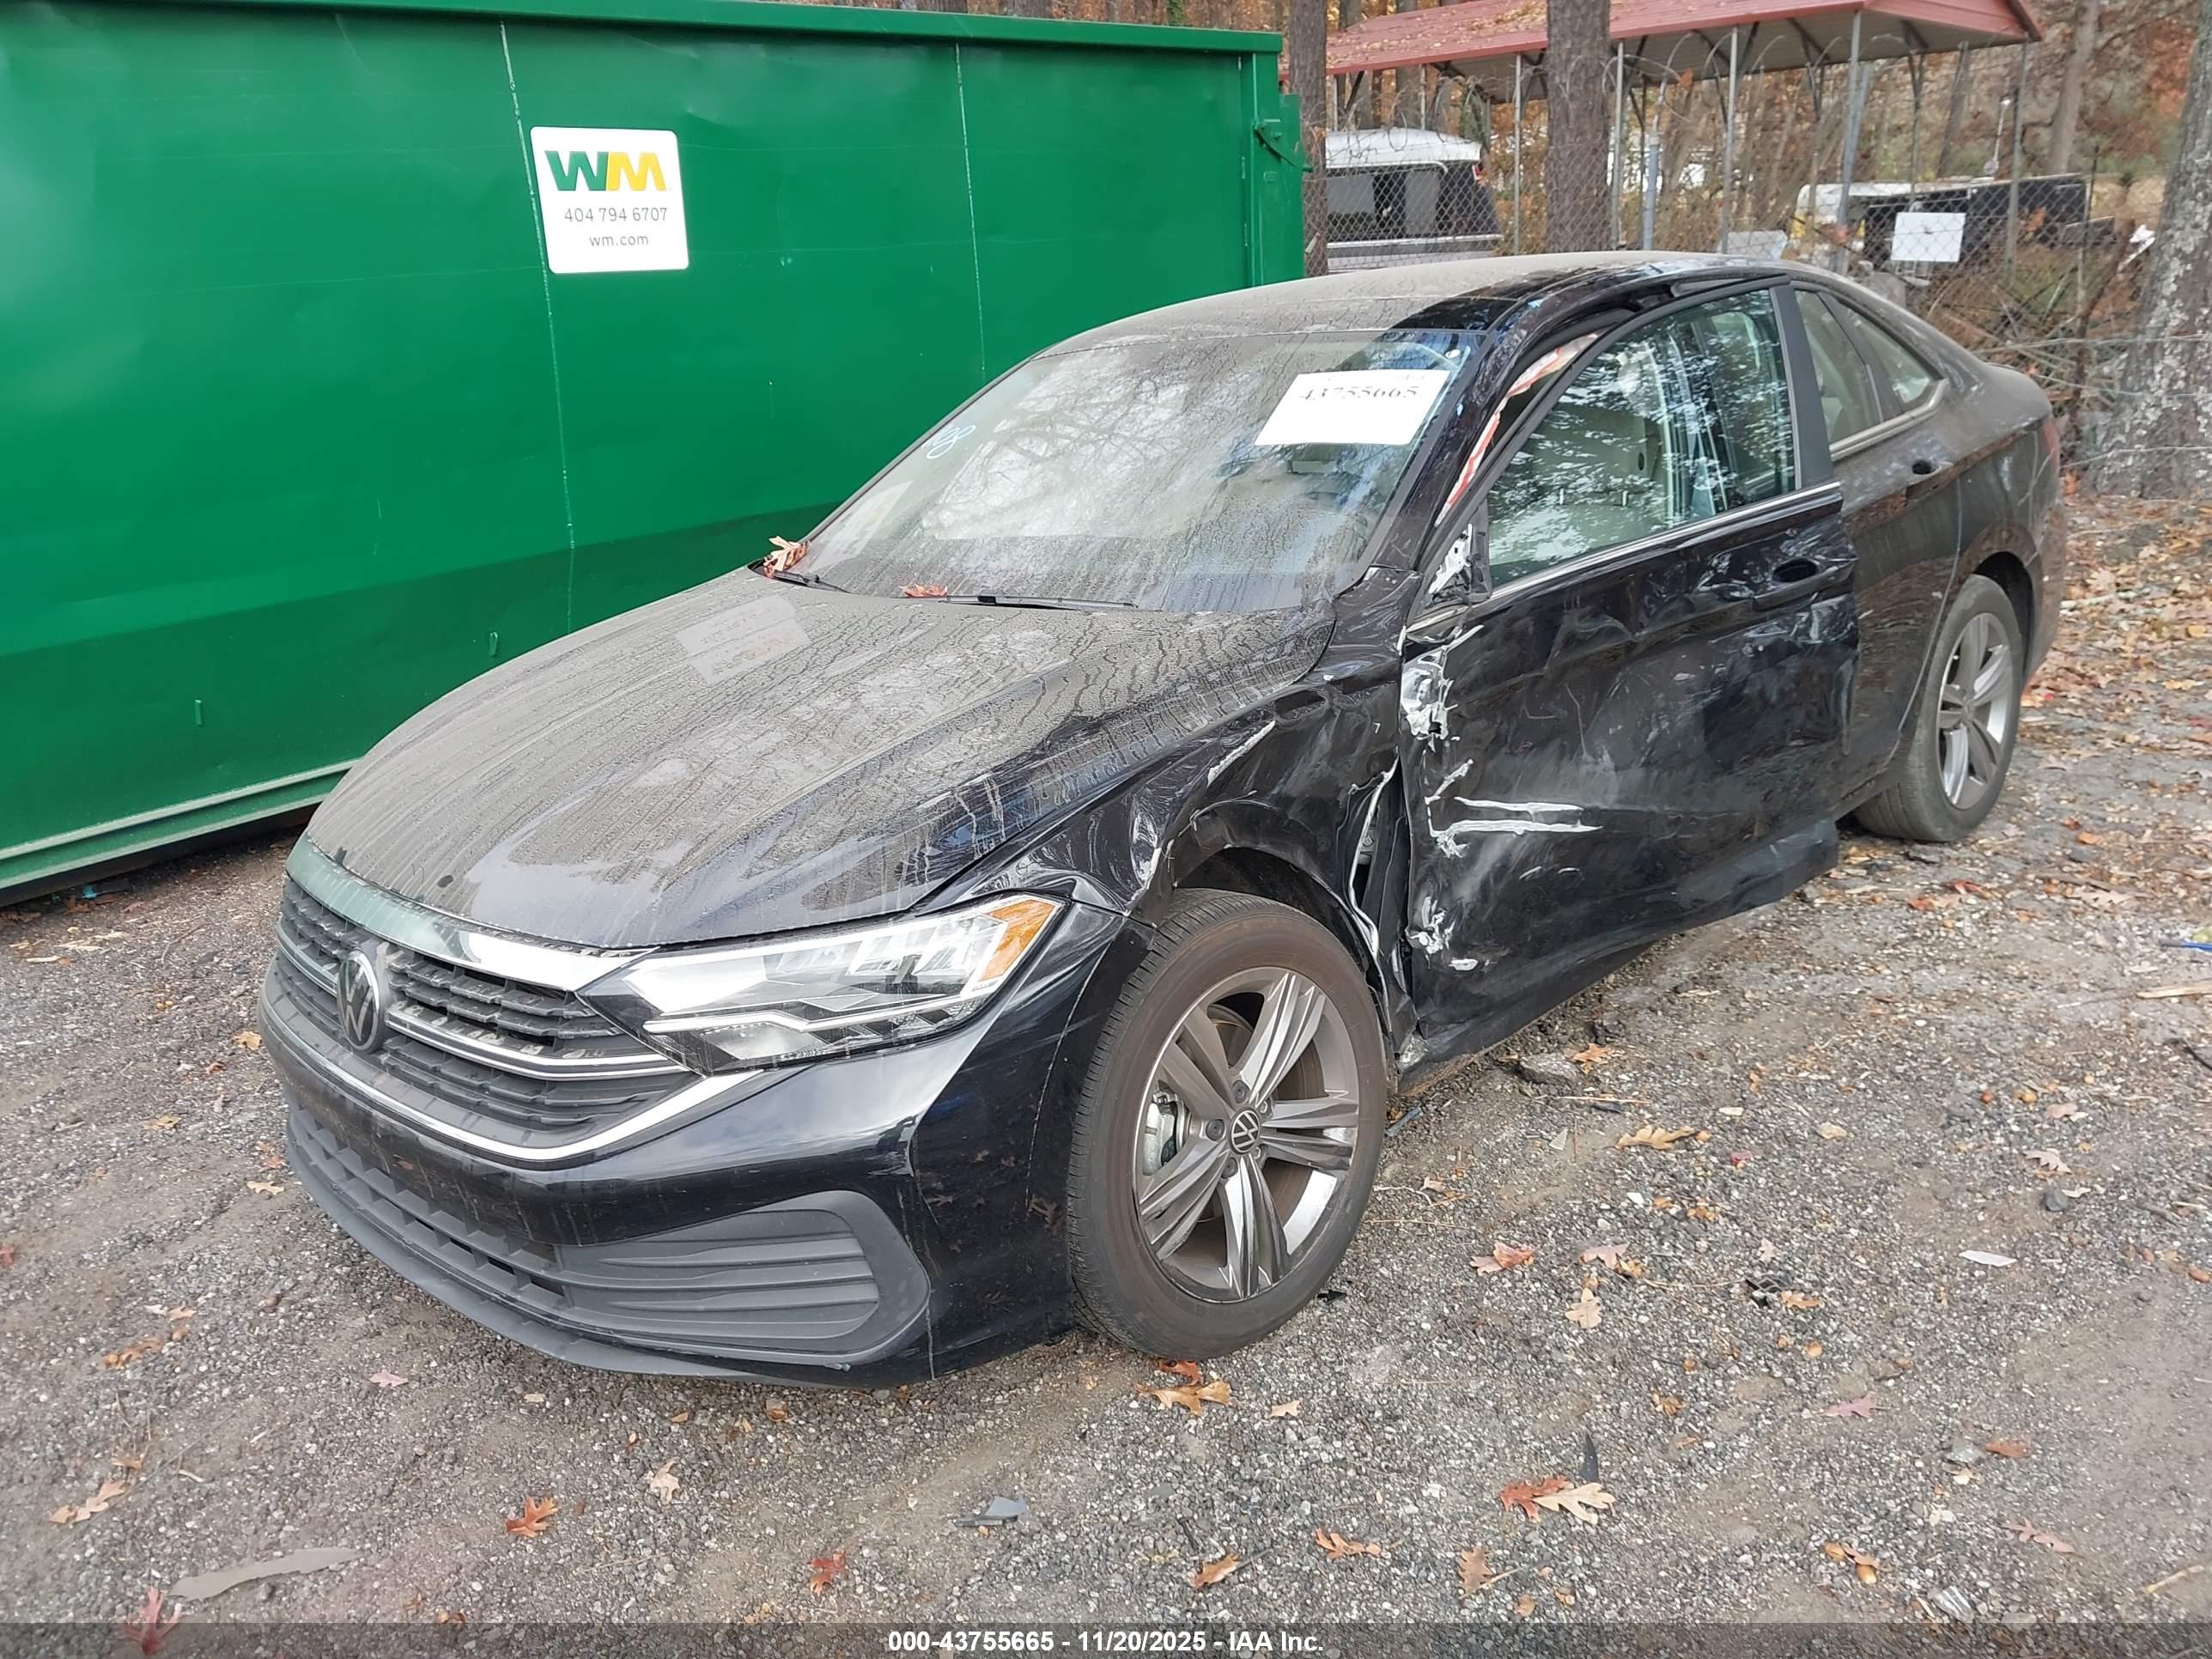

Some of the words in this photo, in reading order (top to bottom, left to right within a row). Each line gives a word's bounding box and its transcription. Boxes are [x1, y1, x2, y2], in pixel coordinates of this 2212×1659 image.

[544, 150, 667, 191] WM
[564, 207, 594, 222] 404
[599, 207, 628, 222] 794
[632, 207, 667, 222] 6707
[589, 235, 649, 246] wm.com
